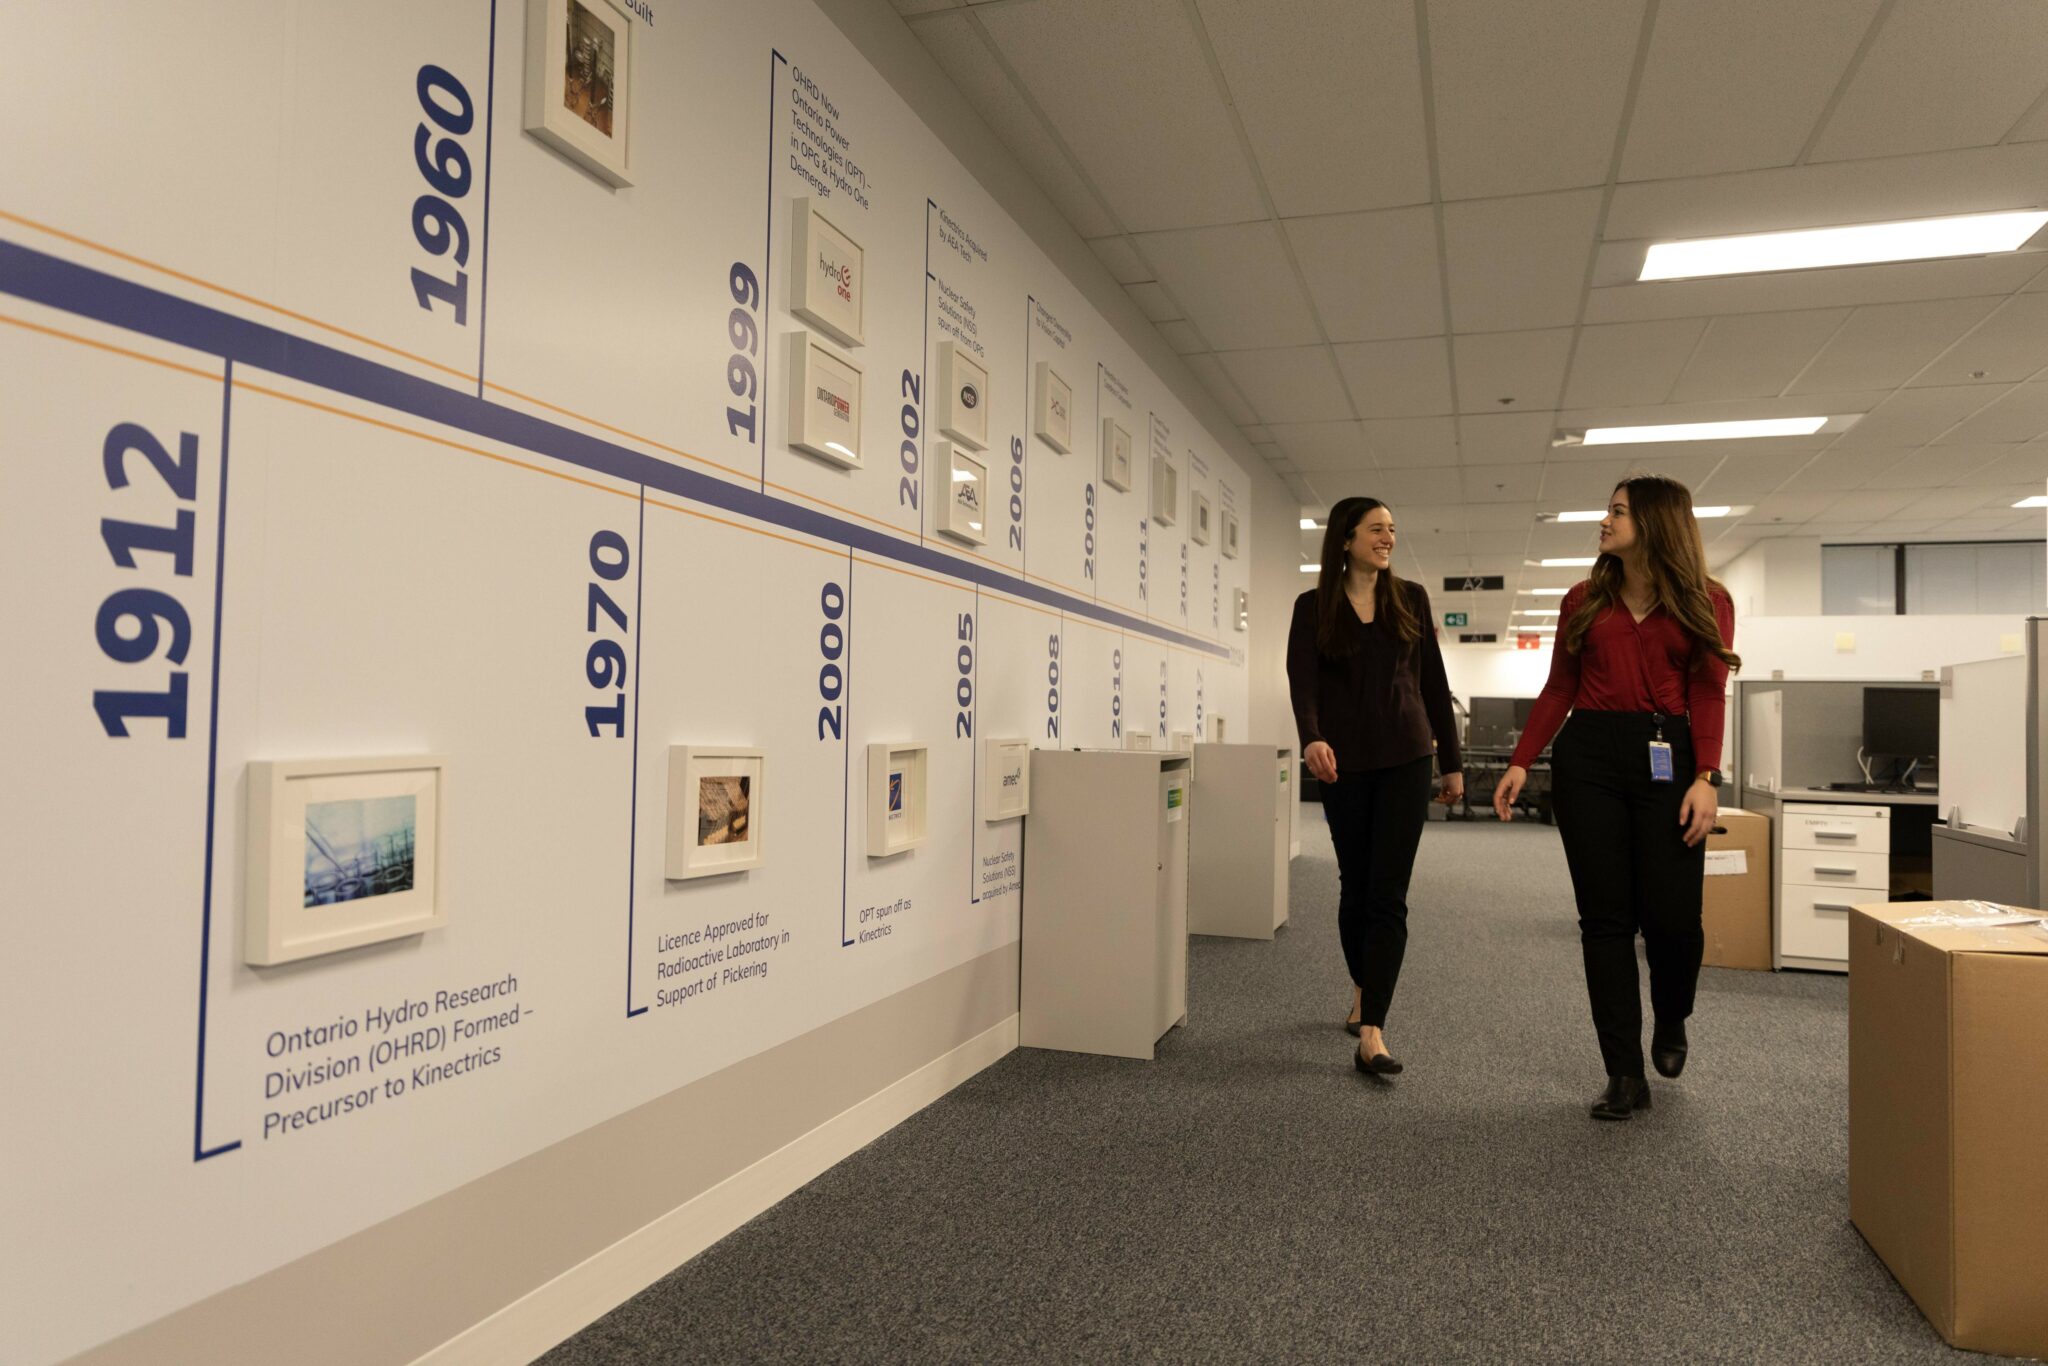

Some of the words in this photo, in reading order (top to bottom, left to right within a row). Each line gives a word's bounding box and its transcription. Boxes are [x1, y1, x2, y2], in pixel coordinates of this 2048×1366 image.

[792, 88, 823, 127] Ontario
[825, 118, 850, 151] Power
[793, 66, 819, 101] OHRD
[821, 93, 839, 120] Now
[791, 109, 843, 166] Technologies
[845, 159, 866, 189] (OPT)
[791, 131, 799, 150] in
[801, 142, 819, 168] OPG
[822, 160, 828, 176] &
[830, 165, 852, 196] Hydro
[854, 188, 869, 210] One
[791, 154, 831, 198] Demerger
[411, 64, 473, 326] 1960
[939, 225, 946, 243] by
[947, 233, 960, 252] AEA
[960, 244, 971, 264] Tech
[820, 251, 841, 281] hydro
[837, 285, 851, 302] one
[939, 278, 959, 303] Nuclear
[938, 296, 963, 325] Solutions
[726, 261, 759, 444] 1999
[963, 387, 976, 406] NSS
[900, 369, 920, 510] 2002
[1010, 435, 1023, 551] 2006
[1085, 483, 1094, 581] 2009
[1139, 518, 1147, 600] 2011
[93, 422, 199, 739] 1912
[1462, 577, 1485, 591] A2
[585, 530, 629, 738] 1970
[818, 582, 844, 741] 2000
[957, 613, 973, 739] 2005
[1047, 634, 1060, 739] 2008
[1112, 649, 1121, 738] 2010
[1003, 773, 1018, 786] amec
[983, 854, 1001, 867] Nuclear
[1001, 850, 1015, 863] Safety
[983, 871, 1004, 884] Solutions
[859, 907, 875, 923] OPT
[876, 903, 892, 921] spun
[893, 898, 903, 913] off
[904, 899, 912, 911] as
[982, 885, 1002, 900] acquired
[657, 949, 723, 980] Radioactive
[726, 933, 779, 960] Laboratory
[781, 930, 790, 946] in
[658, 927, 701, 953] Licence
[704, 912, 753, 944] Approved
[755, 911, 769, 929] for
[859, 923, 892, 944] Kinectrics
[657, 978, 703, 1007] Support
[706, 972, 717, 991] of
[723, 960, 768, 985] Pickering
[266, 1015, 358, 1058] Ontario
[365, 998, 428, 1034] Hydro
[435, 973, 518, 1013] Research
[265, 1054, 361, 1099] Division
[369, 1025, 447, 1073] (OHRD)
[454, 1003, 519, 1042] Formed
[264, 1085, 379, 1140] Precursor
[385, 1076, 405, 1099] to
[411, 1044, 502, 1091] Kinectrics
